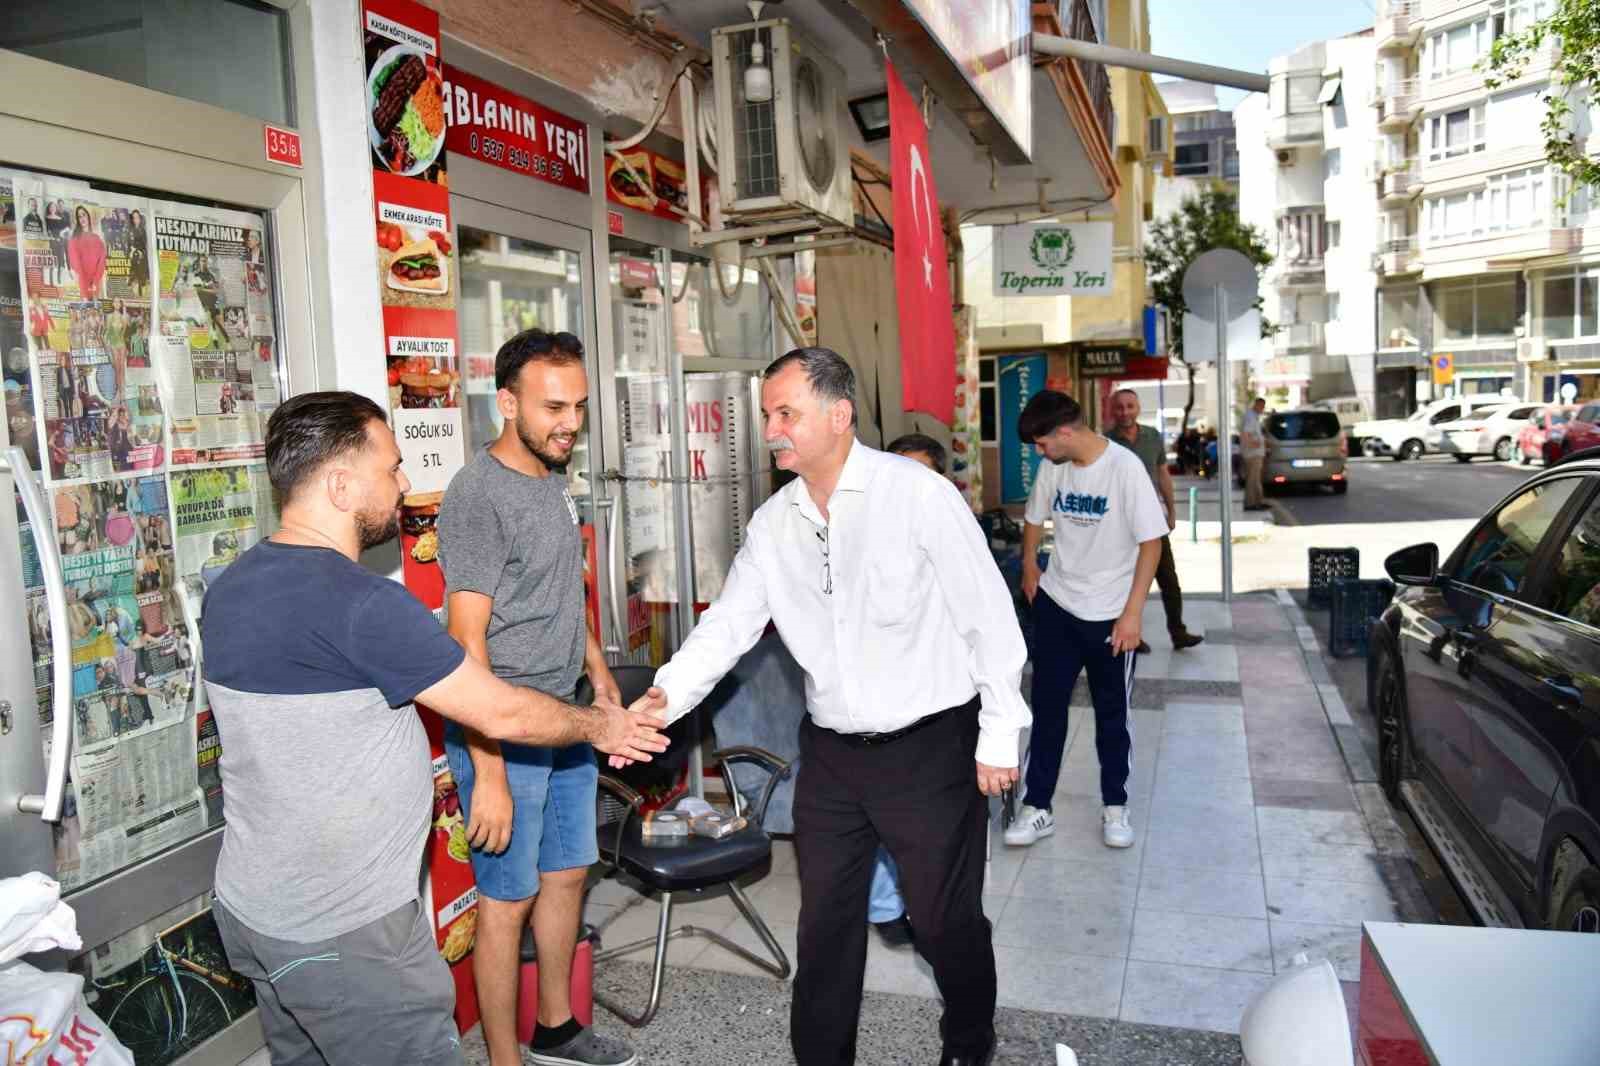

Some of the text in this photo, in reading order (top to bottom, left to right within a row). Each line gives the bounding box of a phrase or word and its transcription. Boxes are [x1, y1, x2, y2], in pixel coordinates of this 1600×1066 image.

[470, 132, 479, 154] 0
[543, 120, 586, 181] YERİ
[384, 208, 406, 221] EKMEK
[424, 215, 442, 229] KÖFTE
[156, 218, 244, 242] HESAPLARIMIZ
[157, 235, 210, 254] TUTMADI
[1000, 271, 1107, 293] Toperin Yeri
[396, 340, 449, 353] AYVALIK TOST
[404, 421, 453, 440] SOĞUK SU
[423, 452, 442, 468] 5 TL
[453, 889, 480, 914] PATATE
